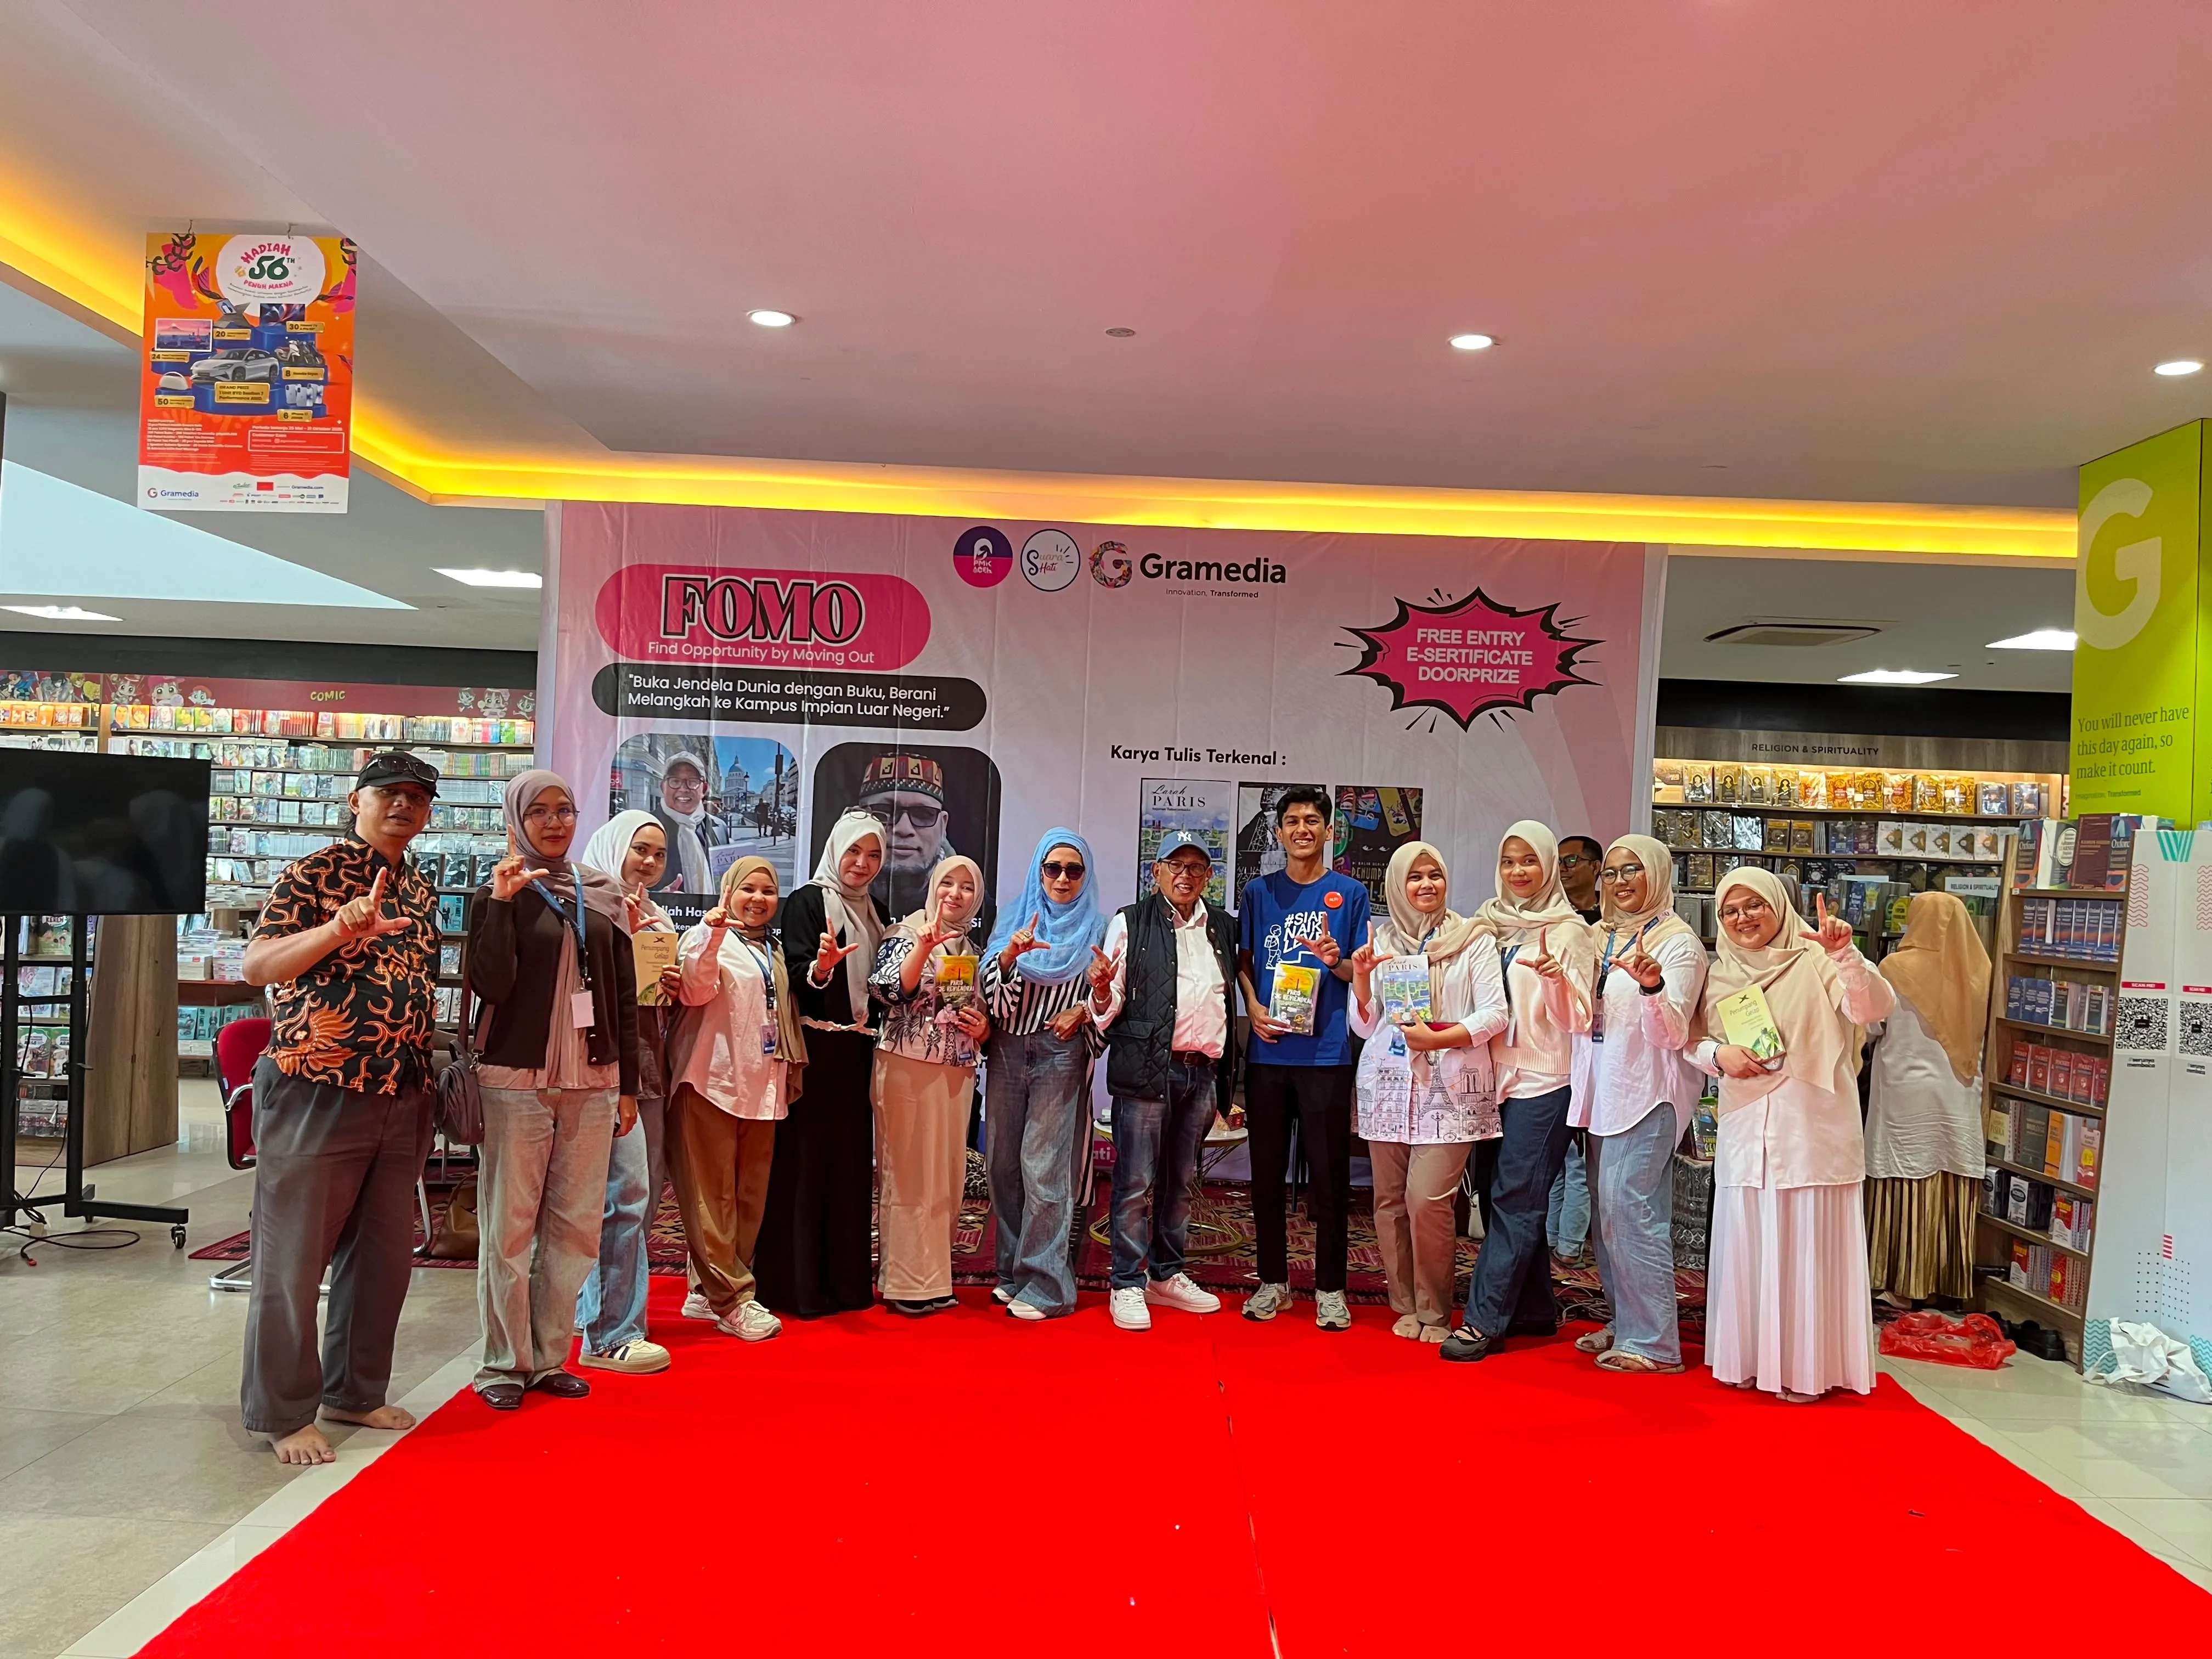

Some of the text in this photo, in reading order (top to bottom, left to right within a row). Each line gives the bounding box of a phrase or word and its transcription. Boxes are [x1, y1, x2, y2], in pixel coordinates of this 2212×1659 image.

[241, 243, 291, 264] HADIAH
[244, 280, 267, 290] PENUH
[268, 280, 294, 290] MAKNA
[161, 489, 199, 498] Gramedia
[1140, 553, 1286, 584] Gramedia
[1166, 589, 1259, 598] Innovation, Transformed
[660, 573, 866, 645] FOMO
[1417, 628, 1525, 646] FREE ENTRY
[648, 641, 874, 665] Find Opportunity by Moving Out
[1407, 647, 1533, 665] E-SERTIFICATE
[1418, 667, 1520, 684] DOORPRIZE
[311, 690, 346, 702] COMIC
[673, 677, 734, 693] Jendela
[737, 680, 781, 695] Dunia
[785, 681, 843, 699] dengan
[847, 685, 885, 701] Buku,
[890, 686, 936, 701] Berani
[628, 692, 711, 712] Melangkah
[715, 695, 731, 710] ke
[735, 697, 798, 714] Kampus
[801, 700, 853, 717] Impian
[857, 703, 889, 716] Luar
[2078, 705, 2189, 733] You will never have
[1111, 745, 1159, 763] Karya
[1165, 747, 1201, 762] Tulis
[1206, 749, 1277, 765] Terkenal
[1751, 743, 1880, 755] RELIGION & SPIRITUALITY
[2077, 733, 2173, 760] this day again, so
[2076, 759, 2155, 780] make it count.
[1153, 795, 1205, 807] PARIS
[2107, 788, 2141, 798] Transformed
[1177, 831, 1192, 842] NY
[686, 907, 707, 917] Has
[1284, 921, 1323, 941] NAIK
[641, 944, 670, 953] Penumpang
[1729, 1000, 1757, 1016] Penumpang
